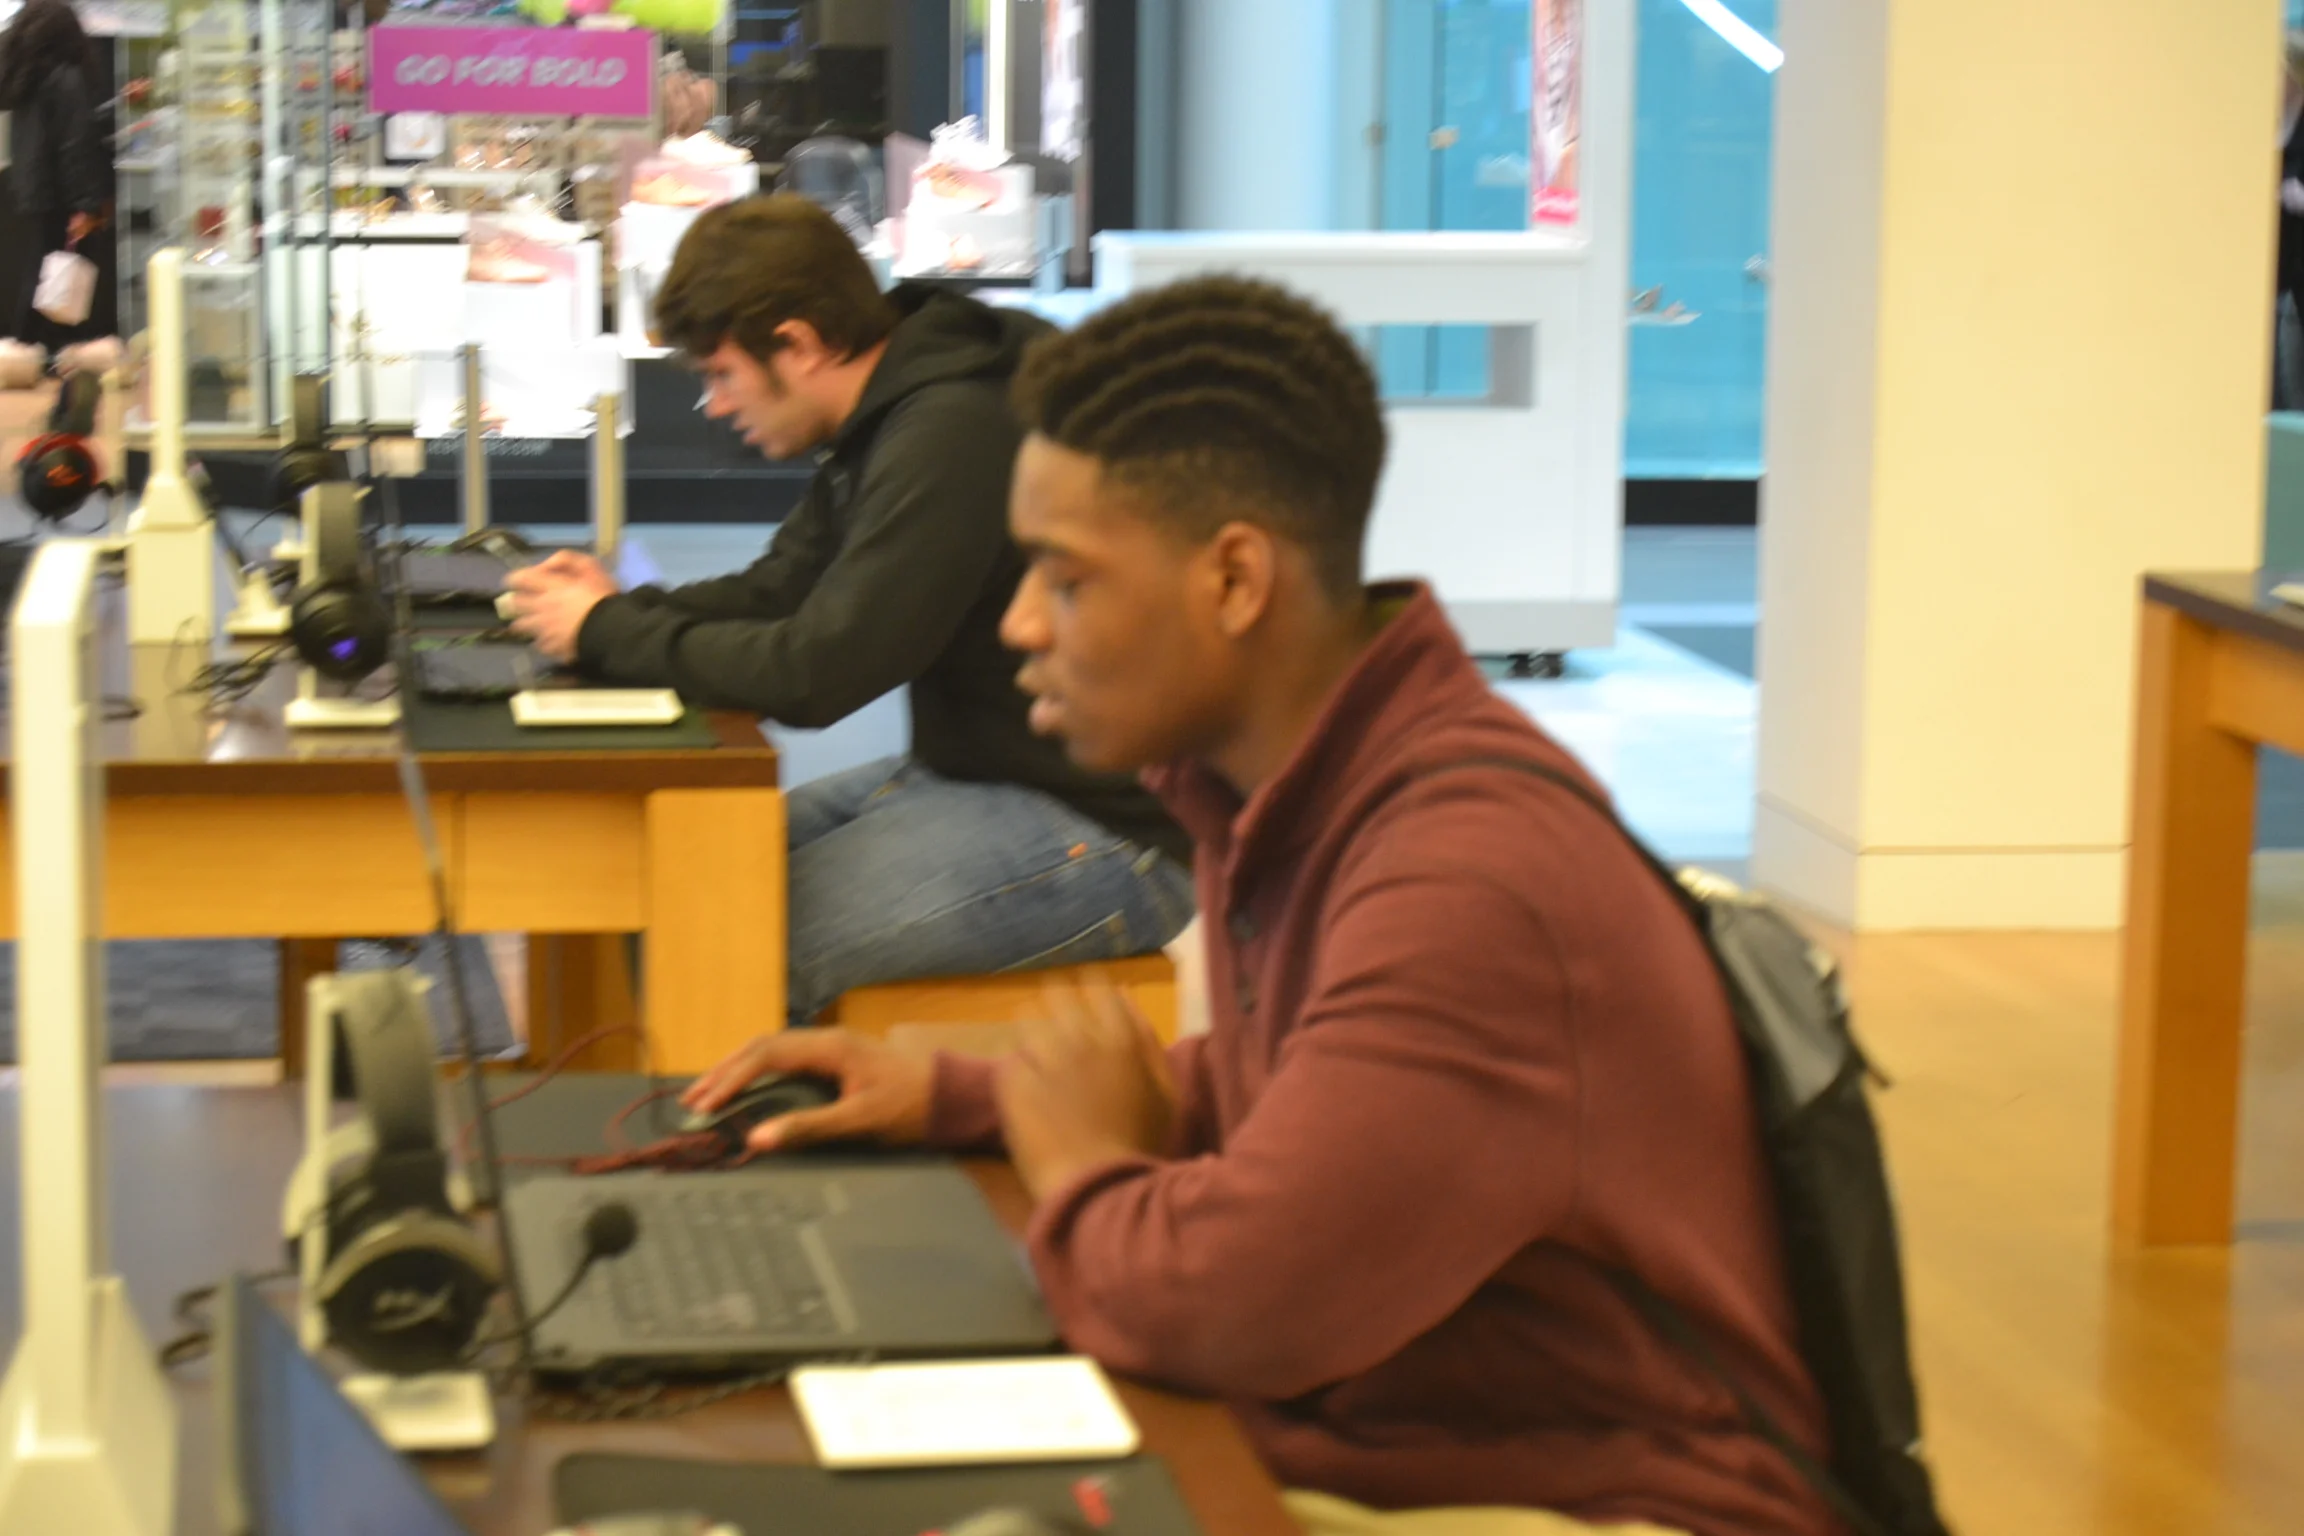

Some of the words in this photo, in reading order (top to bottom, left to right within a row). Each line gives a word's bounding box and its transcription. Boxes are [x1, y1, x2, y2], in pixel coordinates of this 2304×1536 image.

[395, 54, 451, 86] GO
[453, 56, 529, 88] FOR
[530, 57, 628, 88] BOLD
